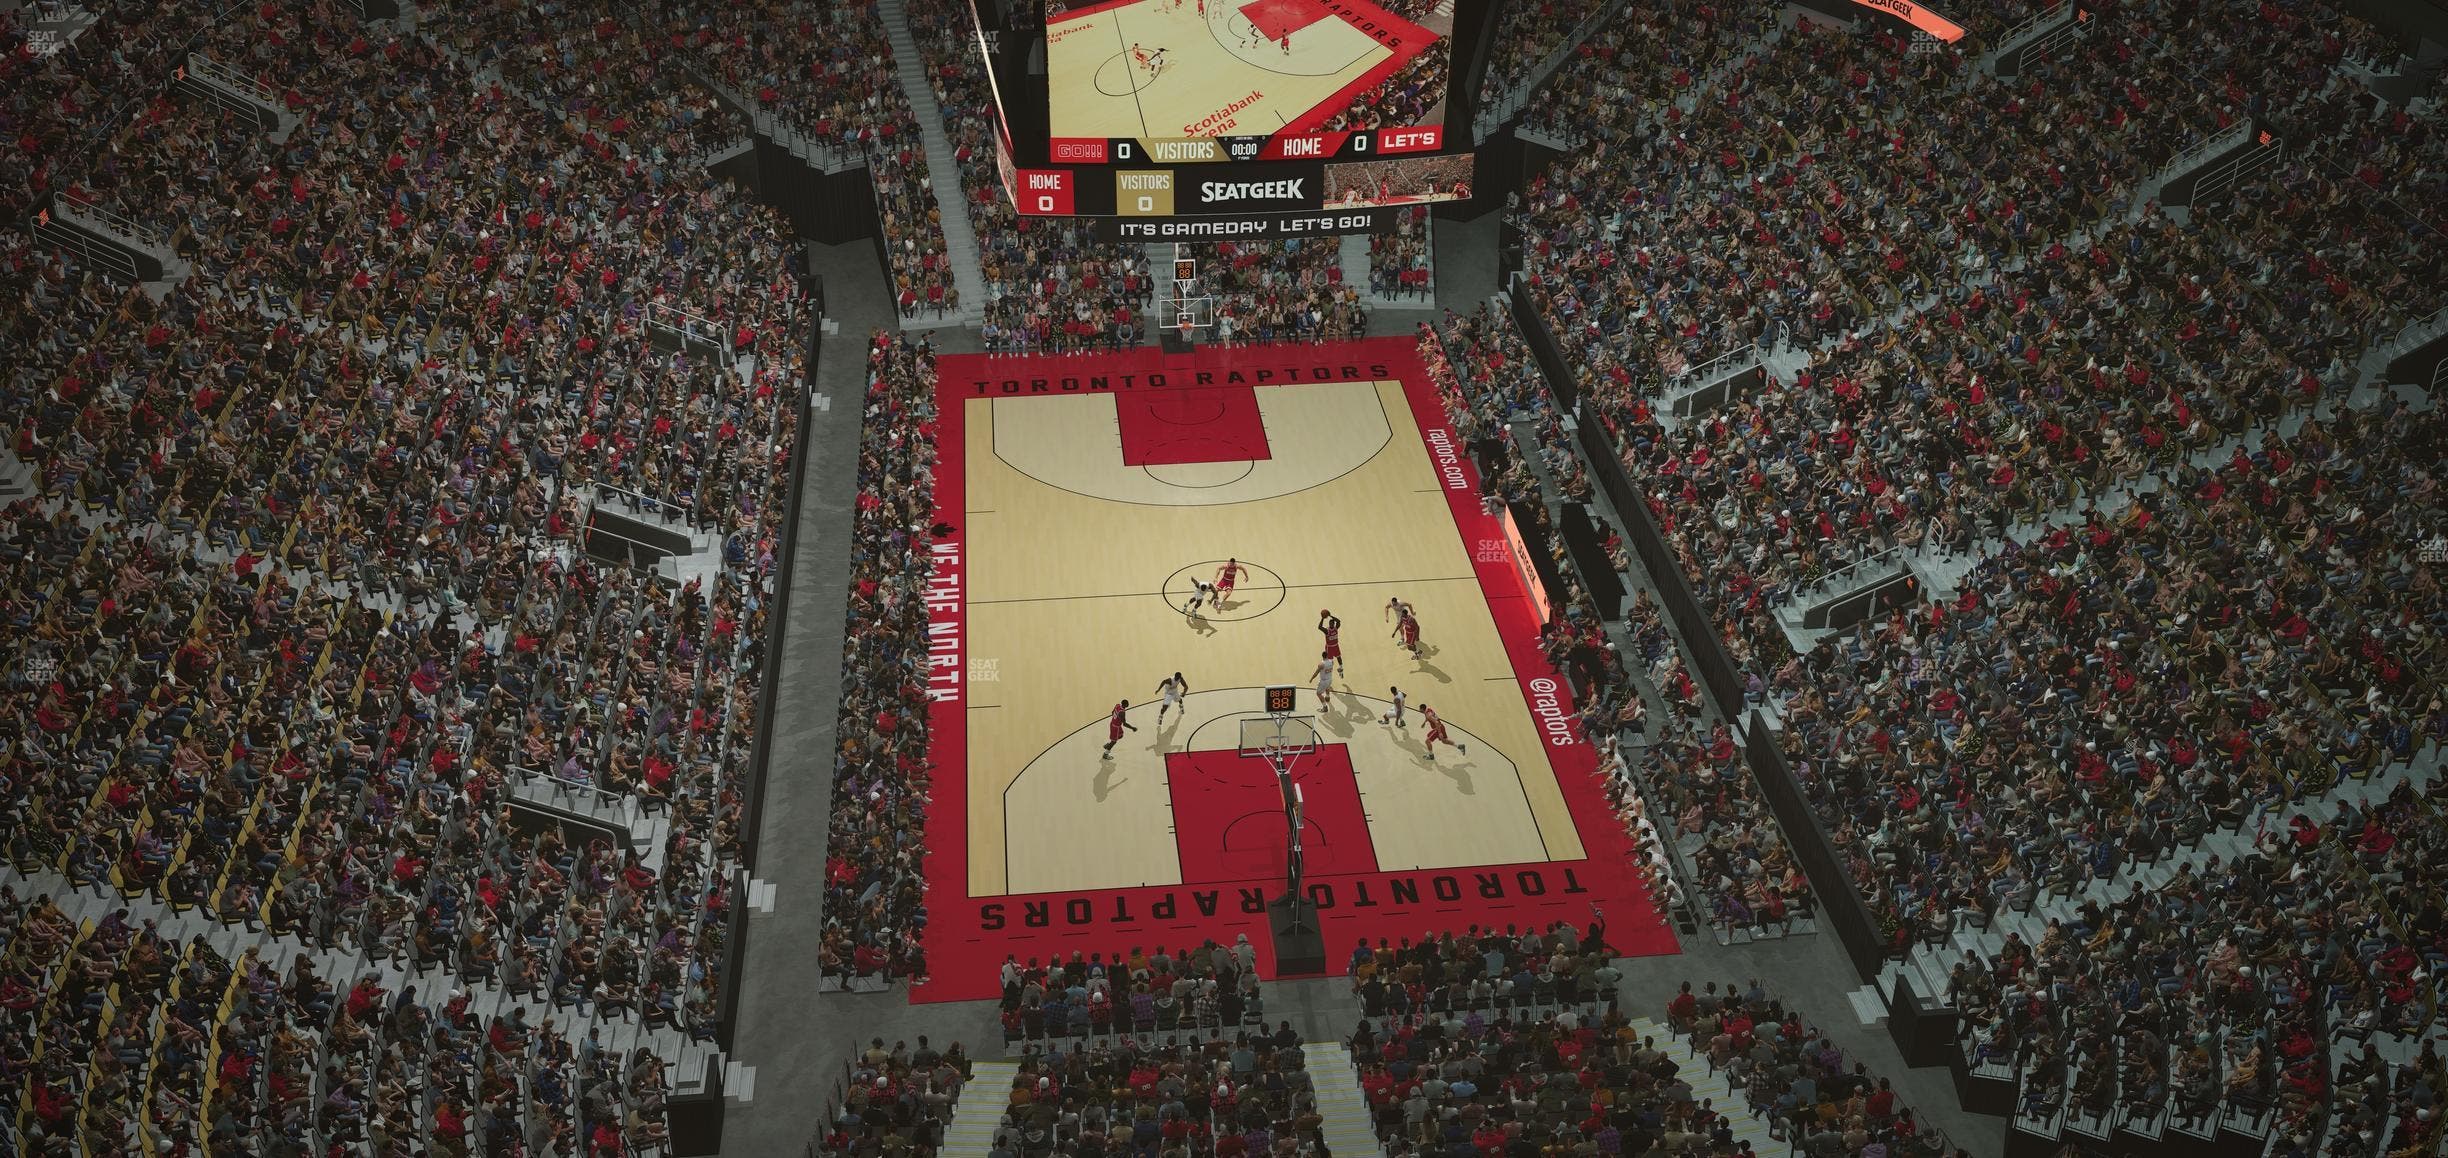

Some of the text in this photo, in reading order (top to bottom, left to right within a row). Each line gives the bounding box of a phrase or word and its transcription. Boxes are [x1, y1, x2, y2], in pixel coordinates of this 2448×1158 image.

[1183, 90, 1264, 138] Scotiabank
[1231, 143, 1257, 156] 00:00
[1283, 137, 1322, 156] HOME
[1354, 135, 1367, 151] 0
[1384, 132, 1435, 148] LET'S
[1118, 143, 1131, 159] 0
[1155, 141, 1214, 160] VISITORS
[1029, 174, 1061, 190] HOME
[1121, 174, 1170, 190] VISITORS
[1201, 178, 1304, 203] SEATGEEK
[1038, 196, 1054, 211] 0
[1138, 196, 1153, 211] 0
[1120, 215, 1371, 236] IT'S GAMEDAY LET'S GO!
[974, 365, 1389, 394] TORONTO RAPTORS
[1427, 429, 1468, 489] raptors.com
[921, 574, 960, 613] THE
[925, 622, 959, 702] NORTH
[1529, 678, 1574, 746] @raptors
[981, 868, 1588, 930] TORONTO RAPTORS
